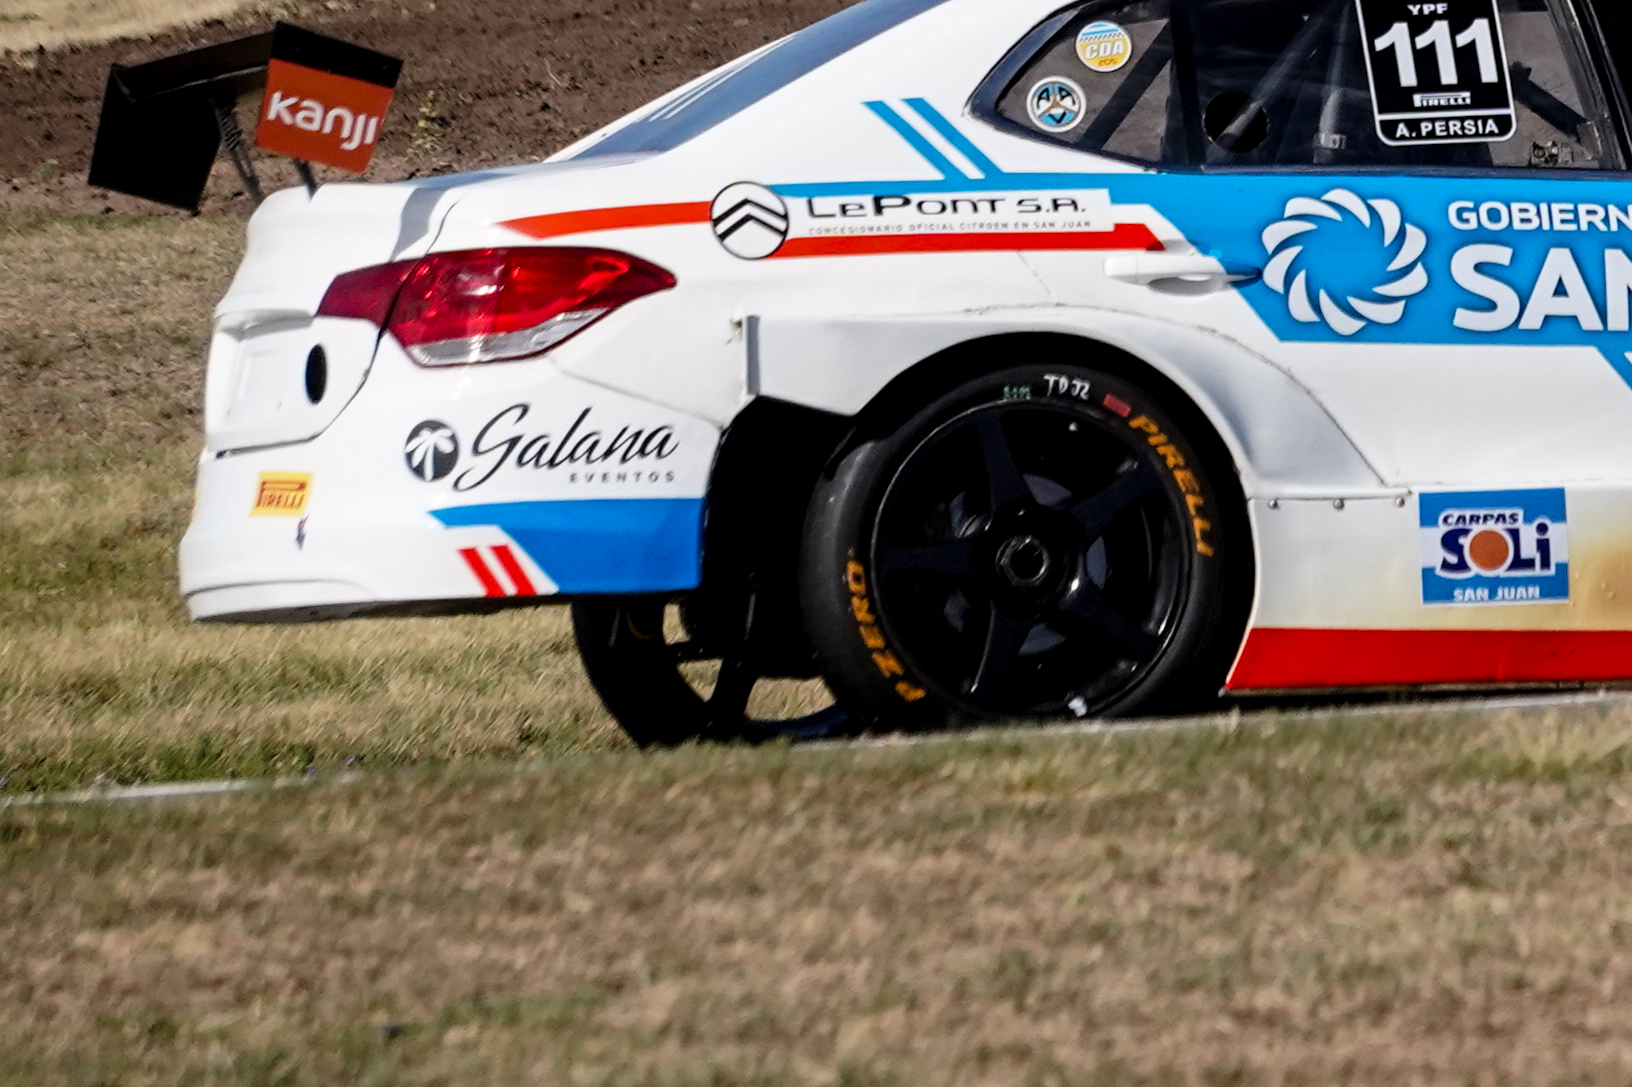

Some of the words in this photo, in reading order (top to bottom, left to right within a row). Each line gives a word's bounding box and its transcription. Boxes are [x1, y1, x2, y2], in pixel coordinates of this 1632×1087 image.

[1406, 2, 1448, 16] YPF
[1373, 17, 1499, 88] 111
[1412, 91, 1471, 108] PIRELLI
[266, 90, 379, 151] kanji
[1395, 122, 1417, 139] A.
[1420, 118, 1499, 137] PERSIA
[1016, 197, 1087, 214] S.A.
[808, 224, 903, 236] CONCESIONARIO
[909, 223, 954, 232] OFICIAL
[1014, 221, 1029, 230] EN
[1033, 220, 1056, 230] SAN
[1061, 220, 1092, 229] JUAN
[451, 401, 681, 492] Galana
[569, 470, 675, 484] EVENTOS
[1128, 415, 1214, 557] PIRELLI
[256, 480, 307, 509] PIRELLI
[1442, 512, 1520, 527] CARPAS
[1453, 586, 1489, 602] SAN
[1494, 584, 1541, 600] JUAN
